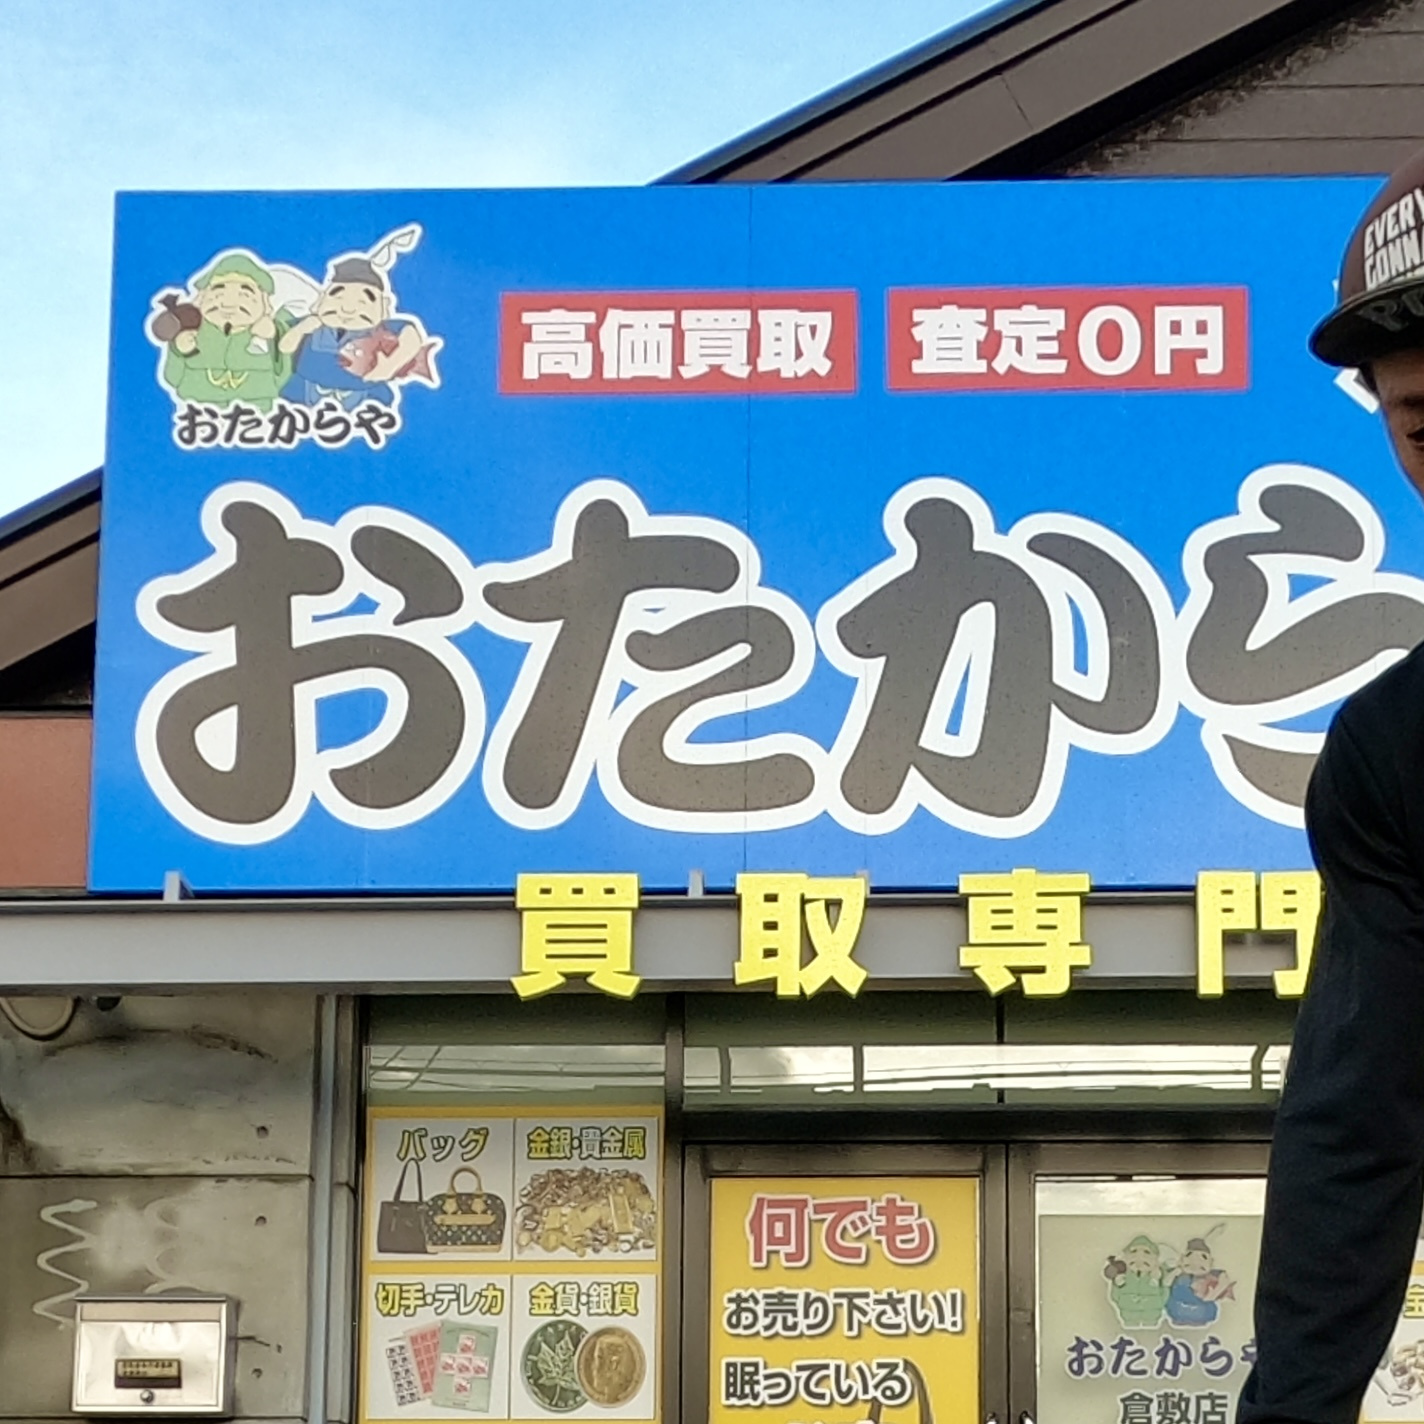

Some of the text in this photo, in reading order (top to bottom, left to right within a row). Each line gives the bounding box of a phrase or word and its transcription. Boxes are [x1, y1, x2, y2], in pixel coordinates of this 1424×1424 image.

[520, 307, 833, 382] 高価買取
[911, 304, 1226, 376] 査定0円
[174, 402, 398, 446] おたからや
[397, 1127, 489, 1162] バッグ
[527, 1126, 646, 1160] 金銀・貴金属
[745, 1194, 936, 1267] 何でも
[376, 1282, 504, 1316] 切手・テレカ
[529, 1282, 639, 1316] 金貨・銀貨
[724, 1290, 966, 1335] お売り下さい!
[721, 1357, 911, 1406] 眠っている
